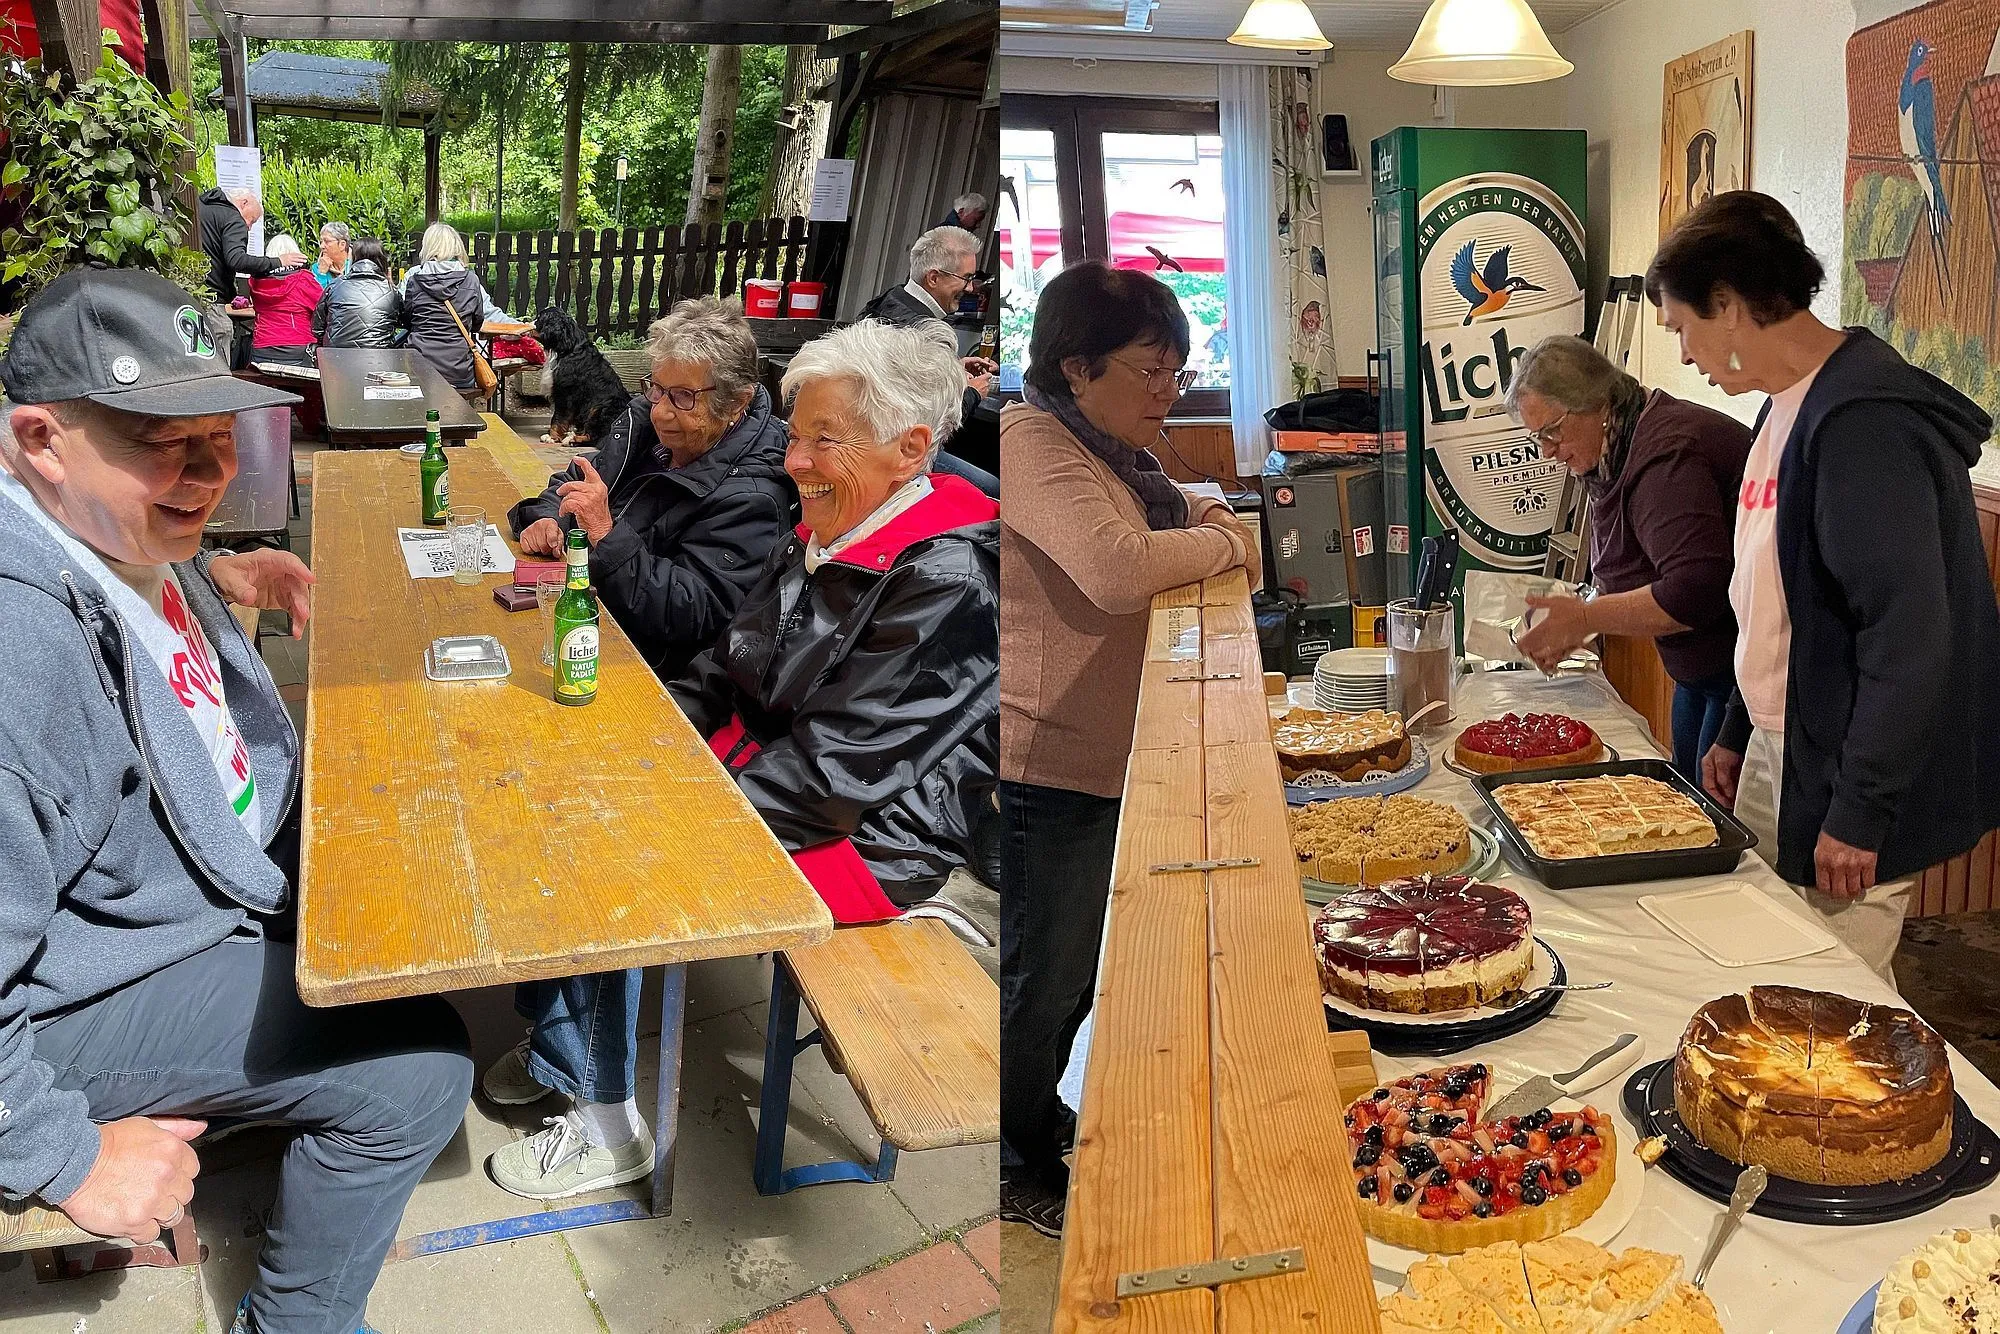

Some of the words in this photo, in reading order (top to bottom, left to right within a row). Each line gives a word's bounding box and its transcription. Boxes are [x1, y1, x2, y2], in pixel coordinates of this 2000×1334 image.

[1437, 194, 1502, 224] HERZEN
[1511, 196, 1540, 219] DER
[1544, 217, 1577, 263] NATUR
[1420, 327, 1528, 425] Lich
[1471, 444, 1541, 472] PILSN
[1493, 464, 1557, 486] PREMIUM
[1435, 474, 1549, 552] BRAUTRADITIO
[568, 645, 597, 660] Licher
[570, 668, 596, 679] RADLER
[571, 661, 595, 671] NATUR
